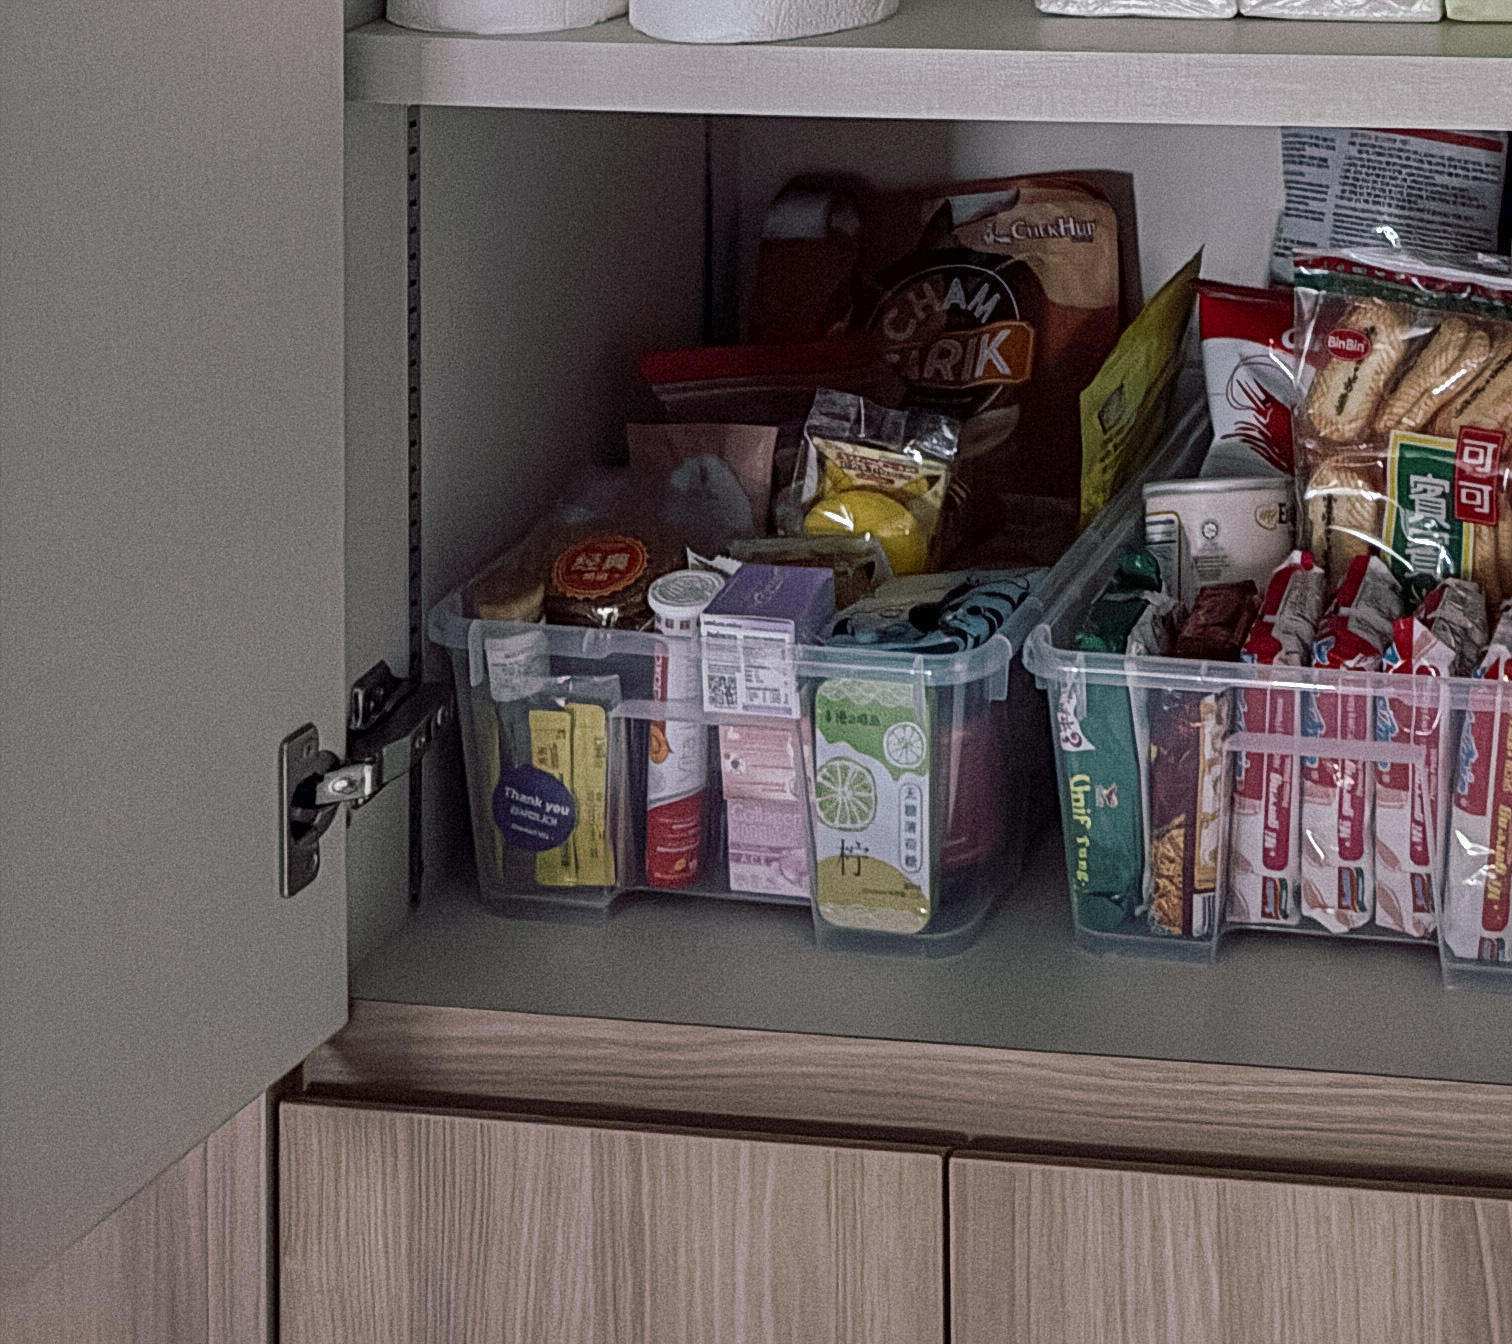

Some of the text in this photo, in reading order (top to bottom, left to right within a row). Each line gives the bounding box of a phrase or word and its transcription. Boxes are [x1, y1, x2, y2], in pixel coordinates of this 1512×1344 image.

[1327, 335, 1367, 354] BinBin
[1457, 438, 1498, 514] 可可
[504, 786, 542, 808] Thank
[545, 801, 570, 816] you
